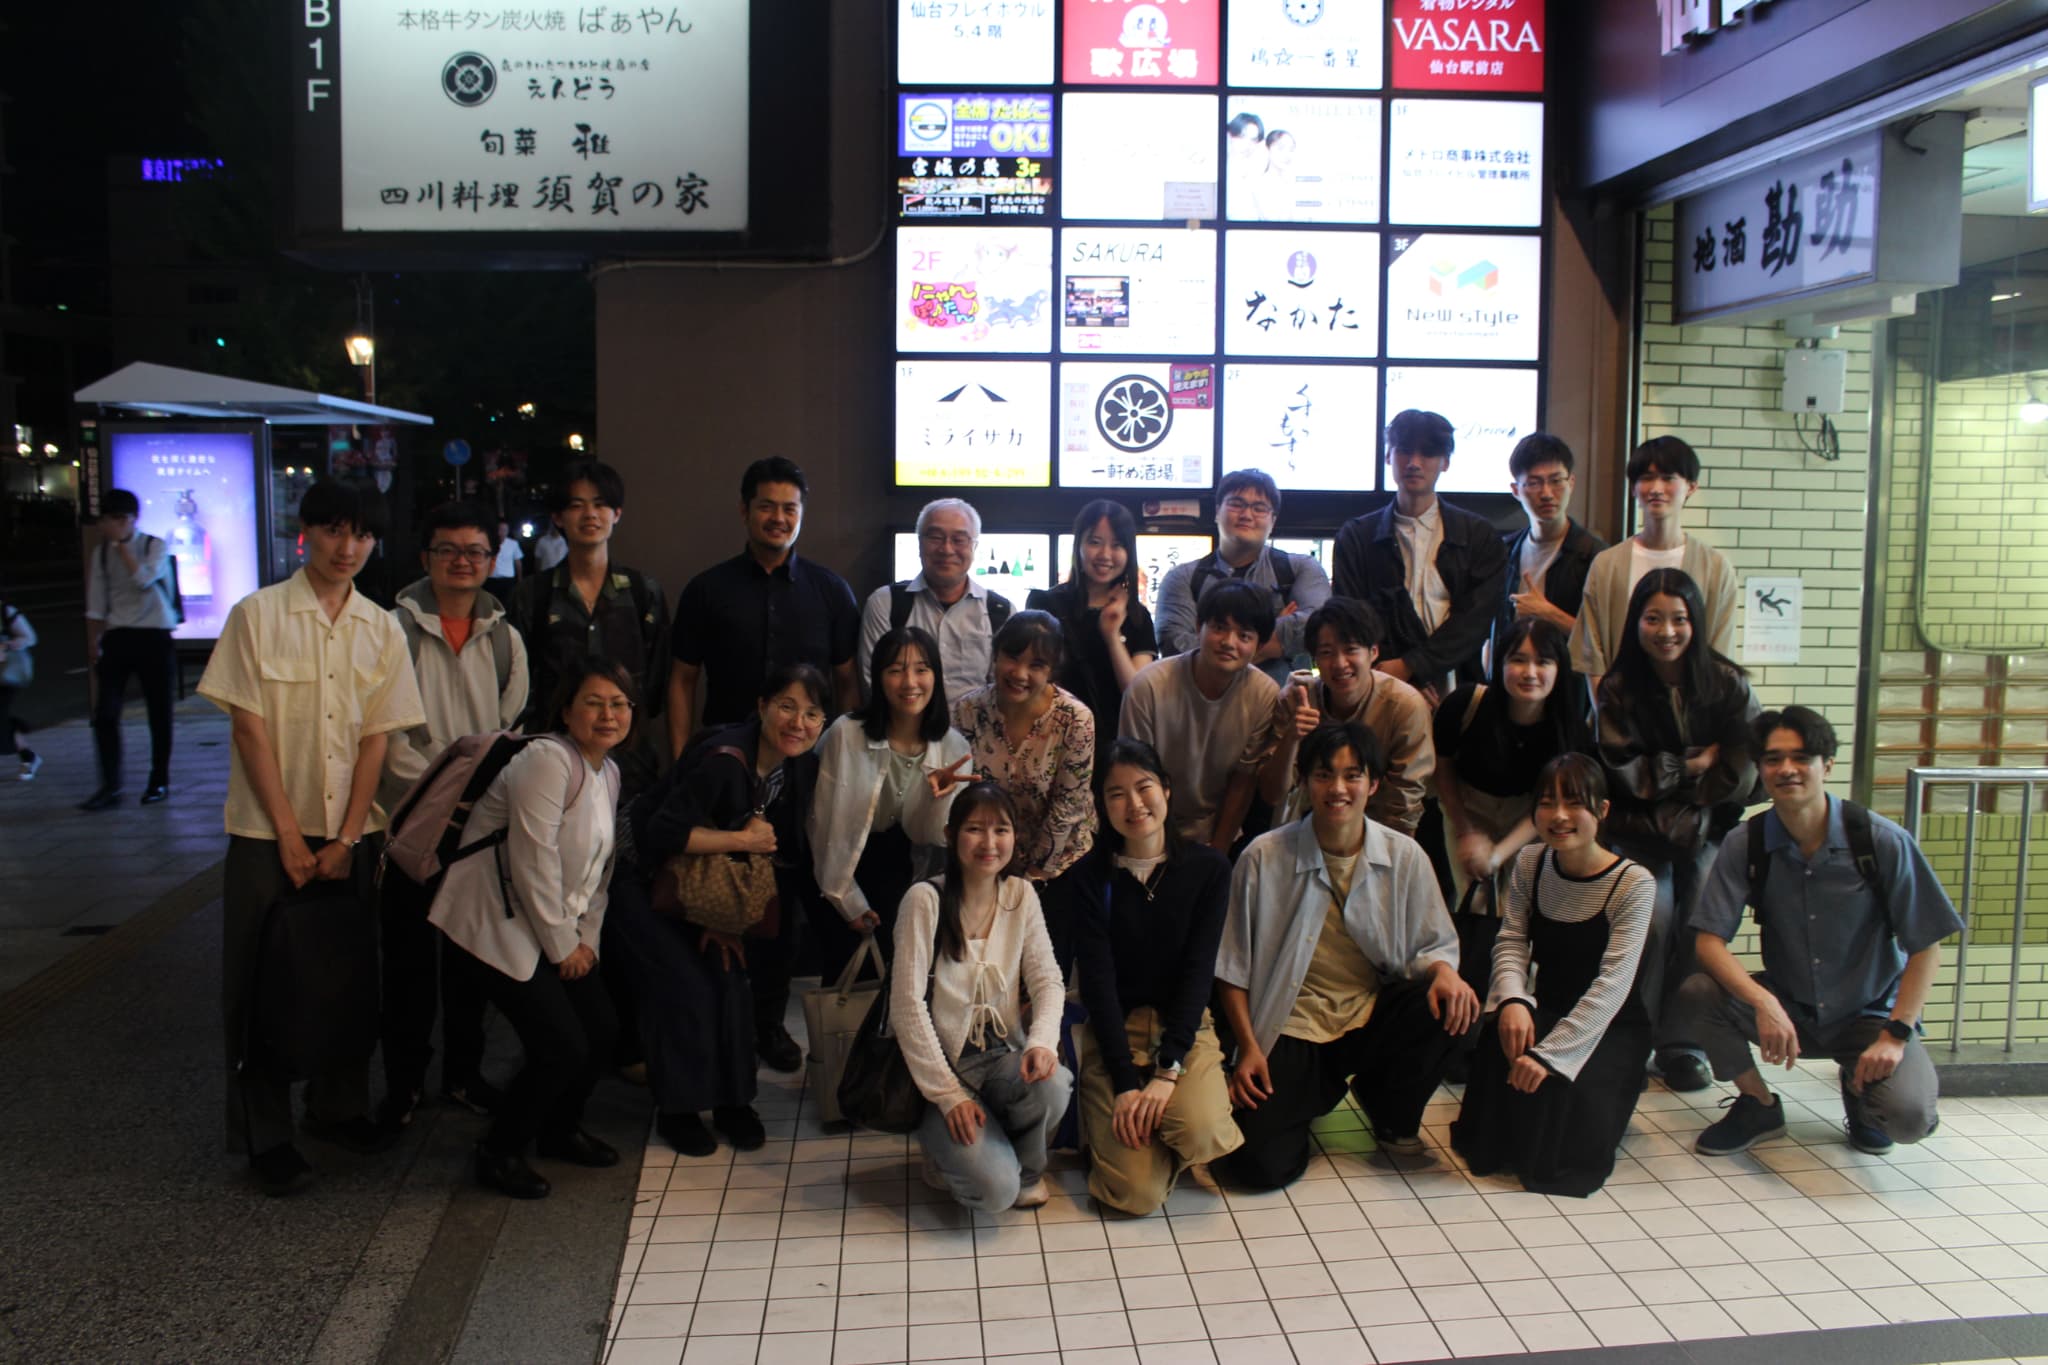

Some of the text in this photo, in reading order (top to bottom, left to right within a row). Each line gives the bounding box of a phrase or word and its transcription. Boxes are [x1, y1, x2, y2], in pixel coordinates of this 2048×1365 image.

[397, 9, 567, 31] 本格牛タン炭火焼
[1393, 18, 1542, 52] VASARA
[1090, 48, 1199, 78] 歌広場
[1430, 59, 1505, 75] 仙台駅前店
[480, 123, 611, 160] 旬菜 雅
[989, 122, 1050, 153] OK!
[1015, 157, 1041, 178] 3F
[380, 172, 711, 216] 四川料理 須賀の家
[1072, 242, 1164, 263] SAKURA
[1394, 238, 1409, 251] 3F
[1693, 216, 1746, 273] 地酒
[911, 250, 943, 272] 2F
[1245, 290, 1360, 332] なかた
[923, 428, 1023, 447] ミライサカ
[1091, 463, 1174, 482] 一軒め酒場
